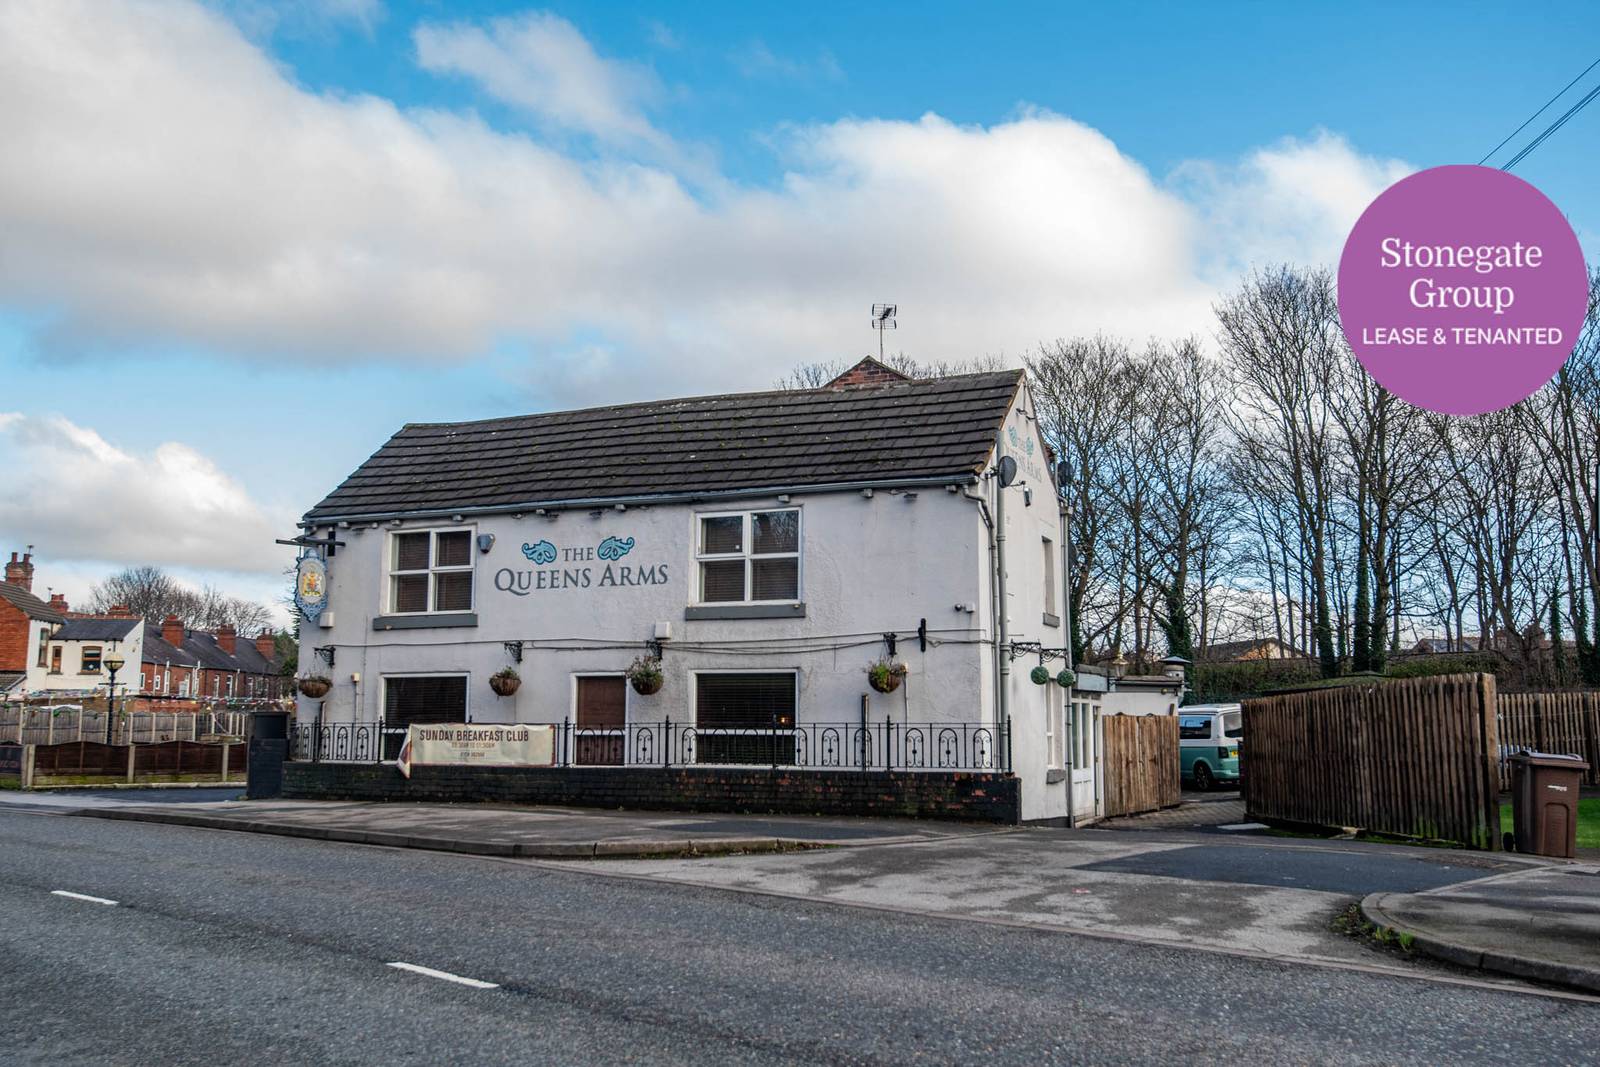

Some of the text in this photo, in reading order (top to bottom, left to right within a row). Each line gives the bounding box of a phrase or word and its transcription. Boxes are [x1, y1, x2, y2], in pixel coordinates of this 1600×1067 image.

[562, 547, 594, 562] THE
[494, 563, 669, 596] QUEENS ARMS
[419, 729, 529, 742] SUNDAY BREAKFAST CLUB
